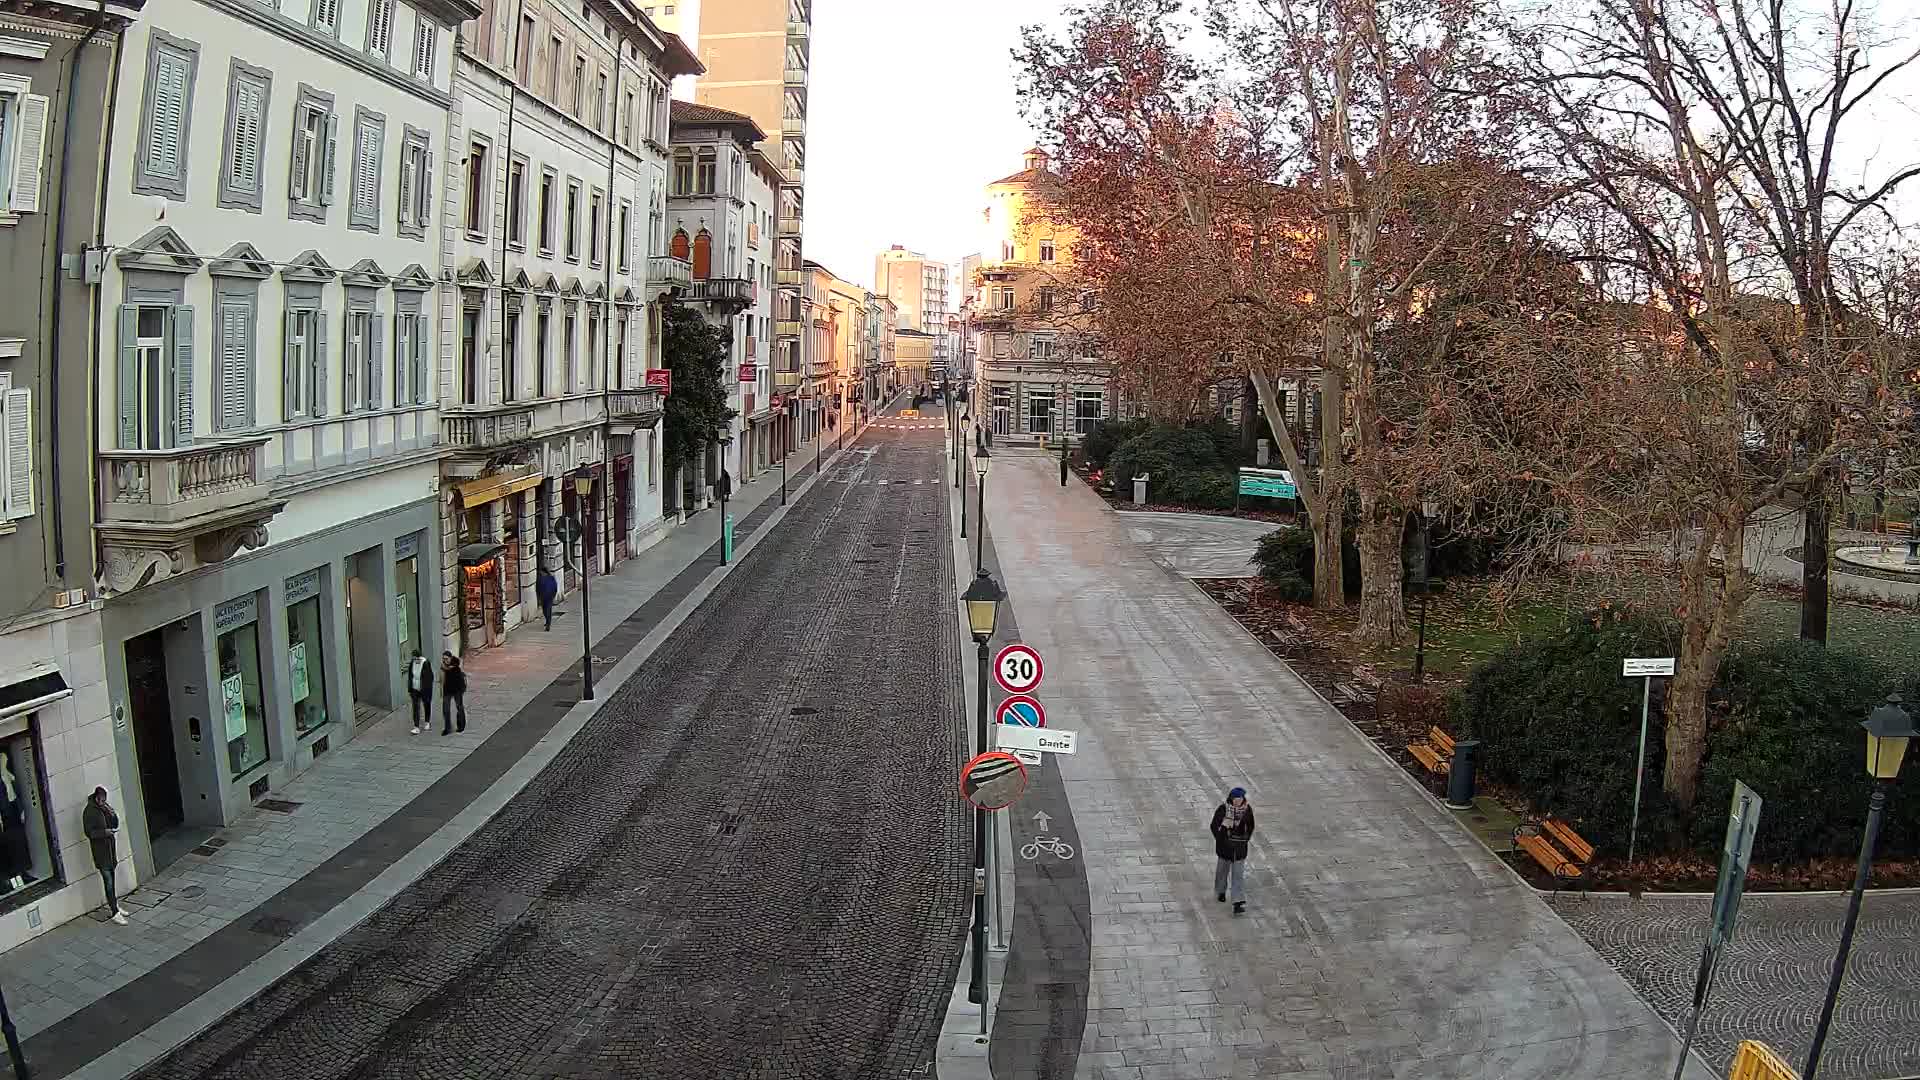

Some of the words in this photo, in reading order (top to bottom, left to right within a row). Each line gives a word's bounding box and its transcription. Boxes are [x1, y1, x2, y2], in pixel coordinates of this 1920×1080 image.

[1006, 658, 1033, 680] 30
[223, 677, 241, 700] 130
[1039, 738, 1070, 749] Dante
